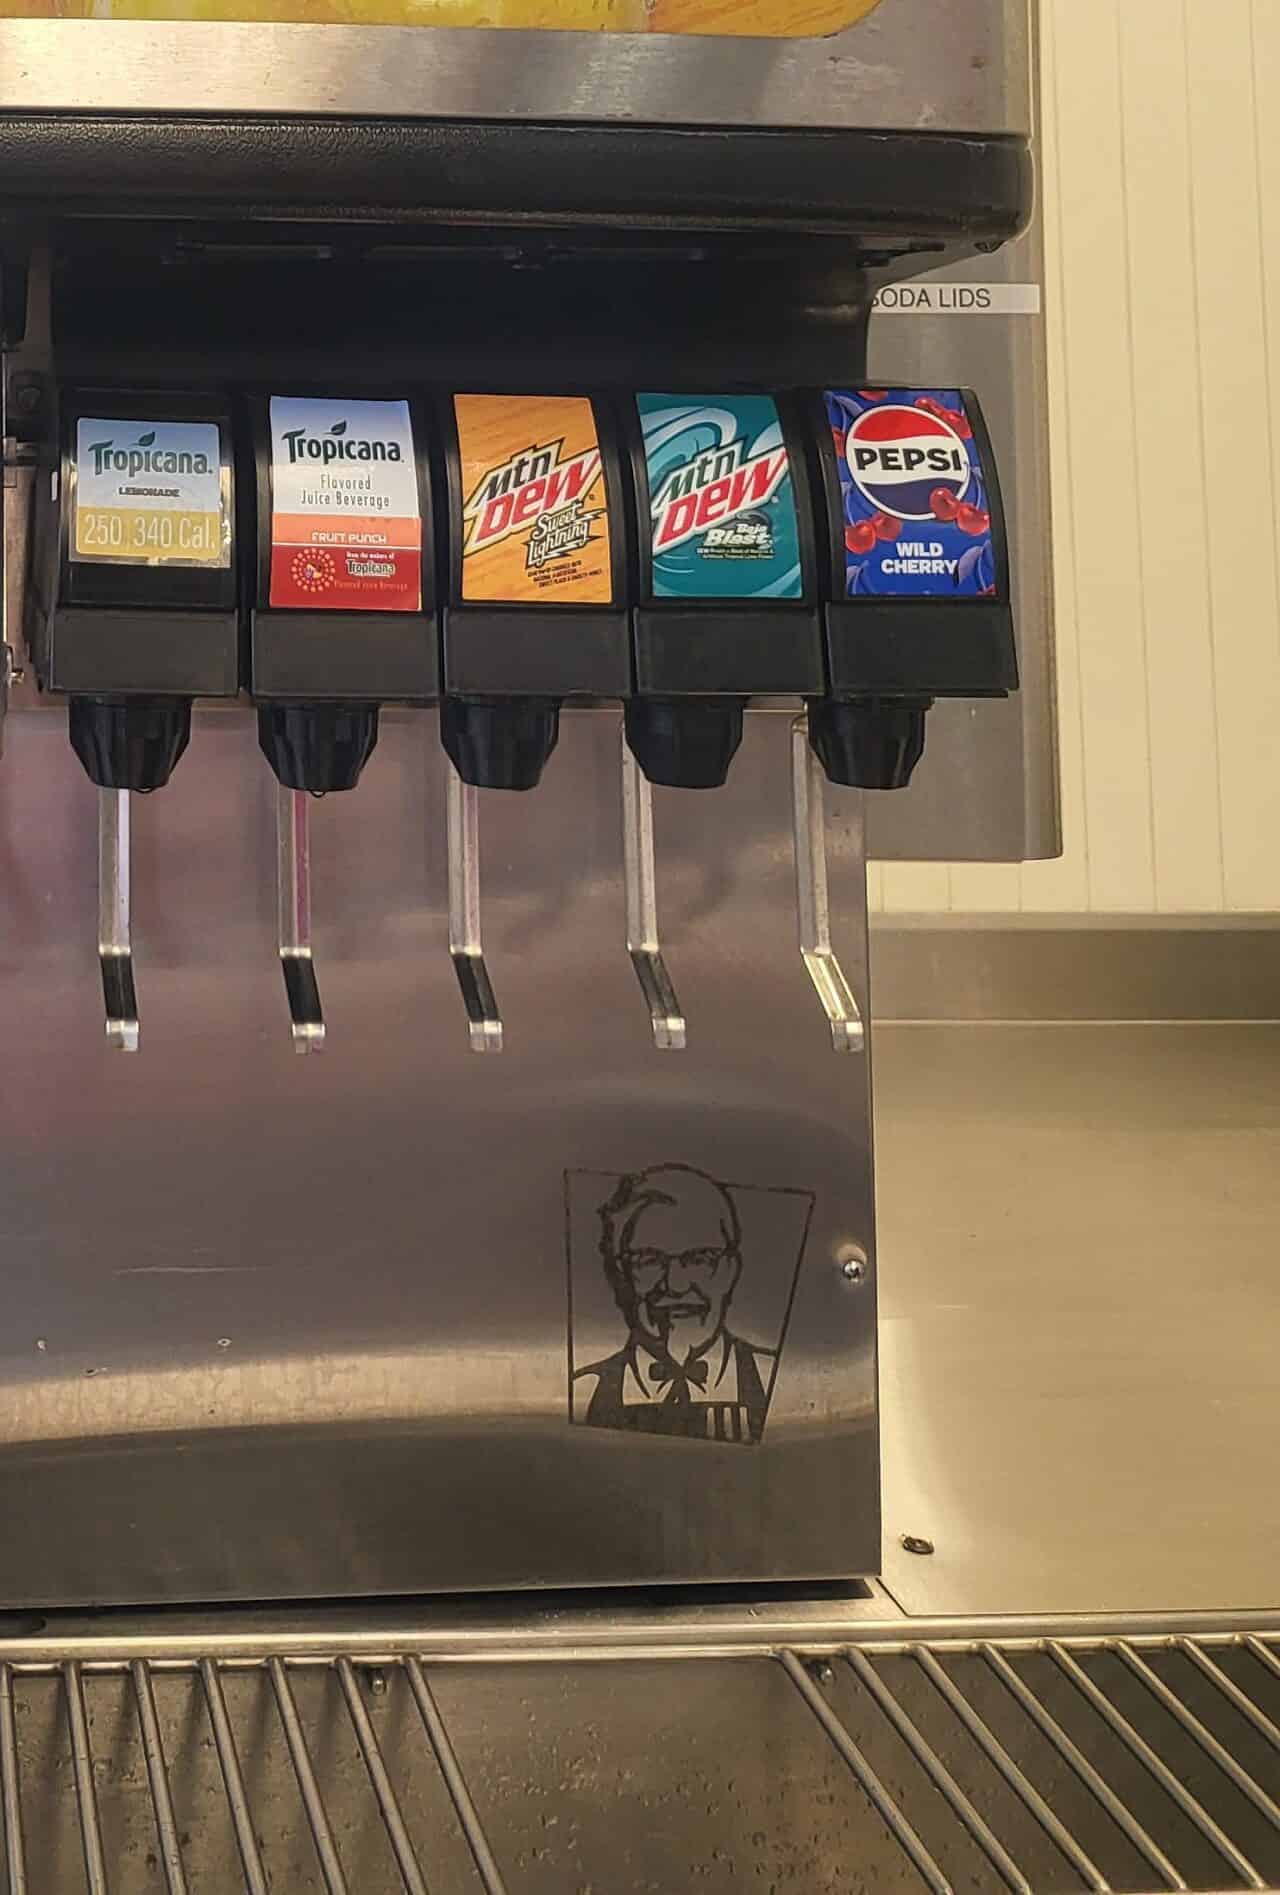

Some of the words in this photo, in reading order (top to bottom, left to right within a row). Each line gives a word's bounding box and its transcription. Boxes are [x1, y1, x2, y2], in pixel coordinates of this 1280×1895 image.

[938, 287, 992, 308] LIDS
[281, 426, 405, 465] Tropicana
[87, 439, 213, 478] Tropicana
[853, 448, 963, 472] PEPSI
[320, 473, 371, 490] Flavored
[472, 451, 551, 509] Mtn
[655, 449, 736, 509] Mtn
[118, 486, 180, 498] LEMONADE
[301, 490, 331, 506] Juice
[336, 491, 390, 511] Beverage
[84, 514, 123, 546] 250
[133, 516, 173, 548] 340
[179, 517, 216, 550] Cal.
[311, 531, 346, 543] FRUIT
[896, 542, 944, 557] WILD
[880, 559, 958, 574] CHERRY
